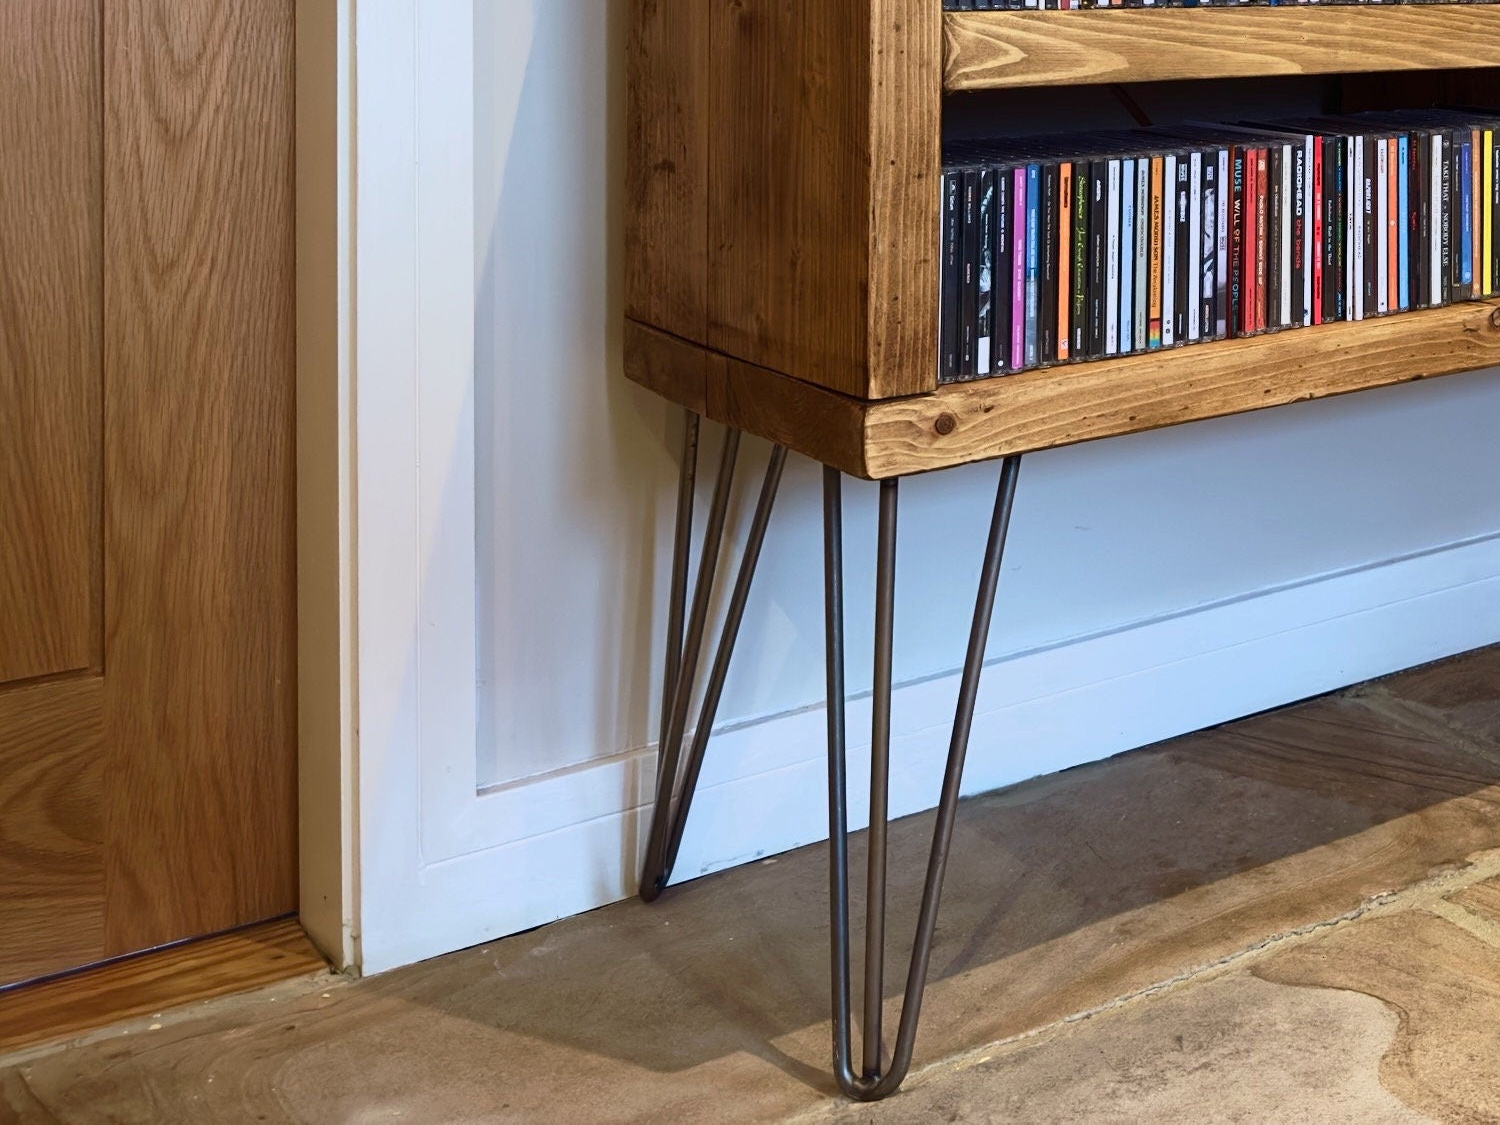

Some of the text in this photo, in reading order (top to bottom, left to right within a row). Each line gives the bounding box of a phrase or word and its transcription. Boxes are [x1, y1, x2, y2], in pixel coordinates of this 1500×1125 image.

[1077, 175, 1087, 220] Stereophonics
[1151, 194, 1160, 222] JAMES
[1257, 194, 1265, 214] PAOLO
[1295, 149, 1303, 270] RADIOHEAD the bends
[1442, 159, 1450, 267] TAKE THAT NOBODY ELSE
[1151, 222, 1160, 261] MORRISON
[1232, 158, 1243, 312] MUSE WILL OF THE PEOPLE
